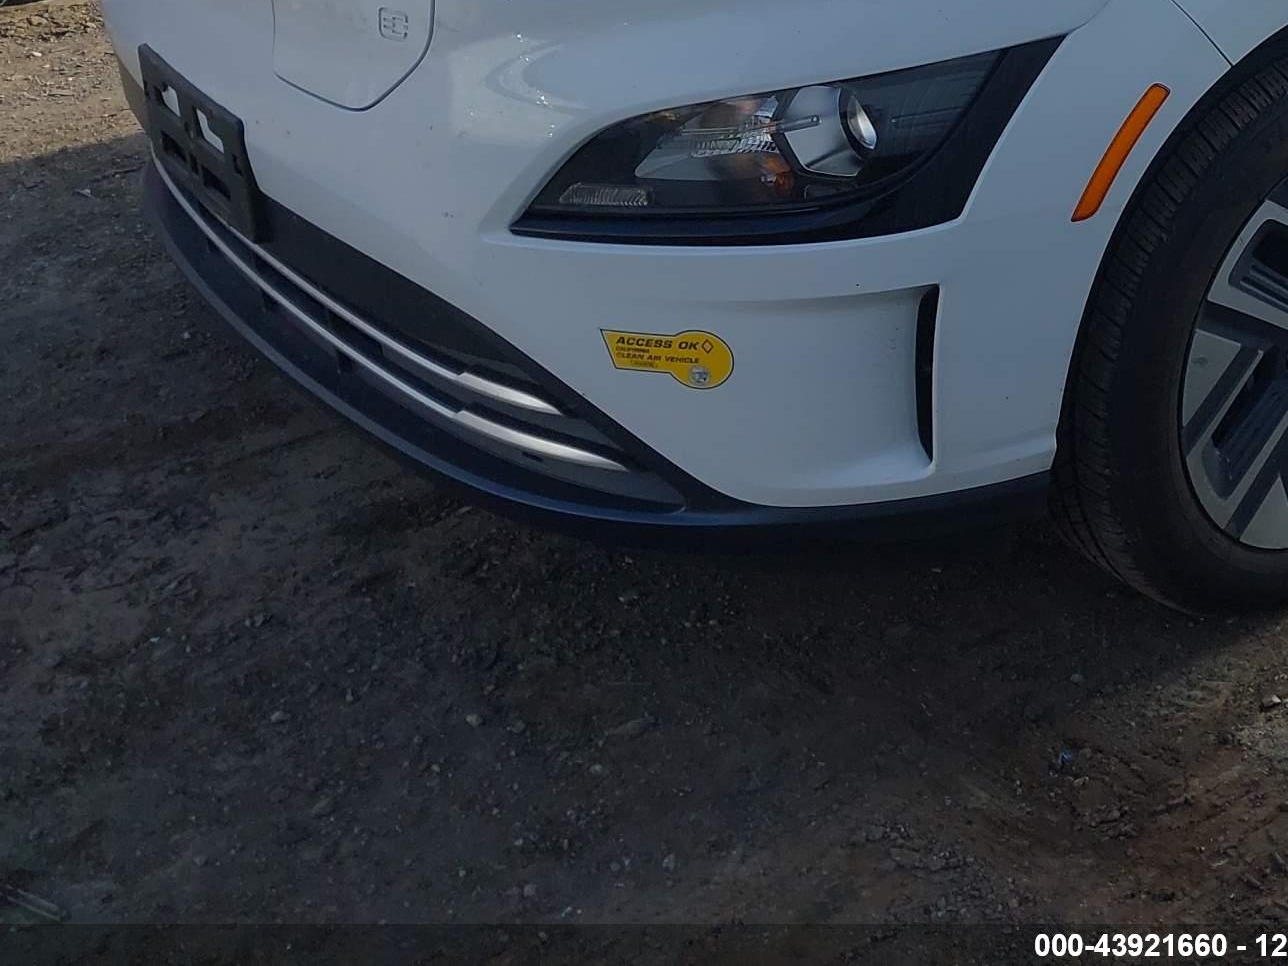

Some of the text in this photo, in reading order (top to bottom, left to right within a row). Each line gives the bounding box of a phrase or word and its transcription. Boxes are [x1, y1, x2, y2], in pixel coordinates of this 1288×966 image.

[616, 336, 700, 350] ACCESS OK
[616, 352, 645, 360] CLEAN
[664, 355, 700, 363] VEHICLE
